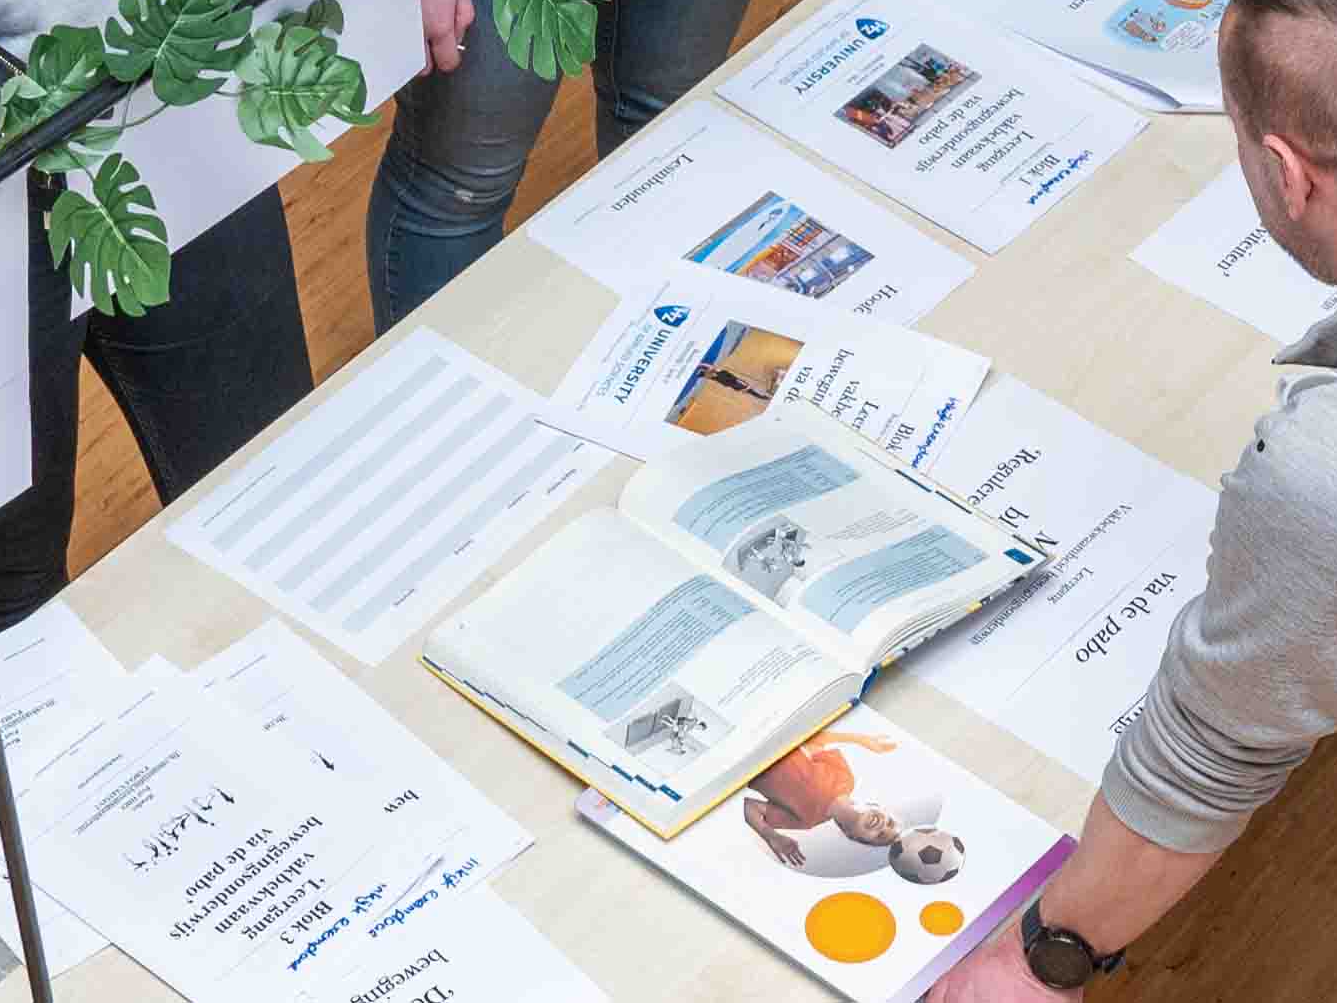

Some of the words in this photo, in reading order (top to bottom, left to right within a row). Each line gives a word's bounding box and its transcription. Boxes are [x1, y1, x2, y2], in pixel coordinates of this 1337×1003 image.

[794, 38, 866, 95] UNIVERSITY
[949, 106, 965, 122] de
[964, 95, 983, 109] via
[915, 88, 1026, 173] bewegingsonderwijs
[918, 118, 949, 146] pabo
[951, 113, 1023, 170] vakbekwaam
[974, 130, 1035, 173] Leergang
[1028, 154, 1062, 177] Blok
[611, 153, 695, 212] Lesinhouden
[614, 328, 675, 405] UNIVERSITY
[795, 365, 813, 384] via
[783, 386, 802, 405] de
[885, 423, 916, 451] Blok
[1057, 503, 1133, 575] Vakbekwaamheid
[1046, 566, 1095, 605] Leergang
[1143, 571, 1179, 597] via
[1120, 596, 1151, 620] de
[1075, 614, 1122, 663] pabo
[383, 789, 420, 815] bew
[245, 828, 273, 848] via
[227, 846, 247, 866] de
[169, 816, 324, 941] bewegingsonderwijs
[214, 851, 316, 935] vakbekwaam
[295, 900, 334, 935] Blok
[279, 931, 295, 945] 3
